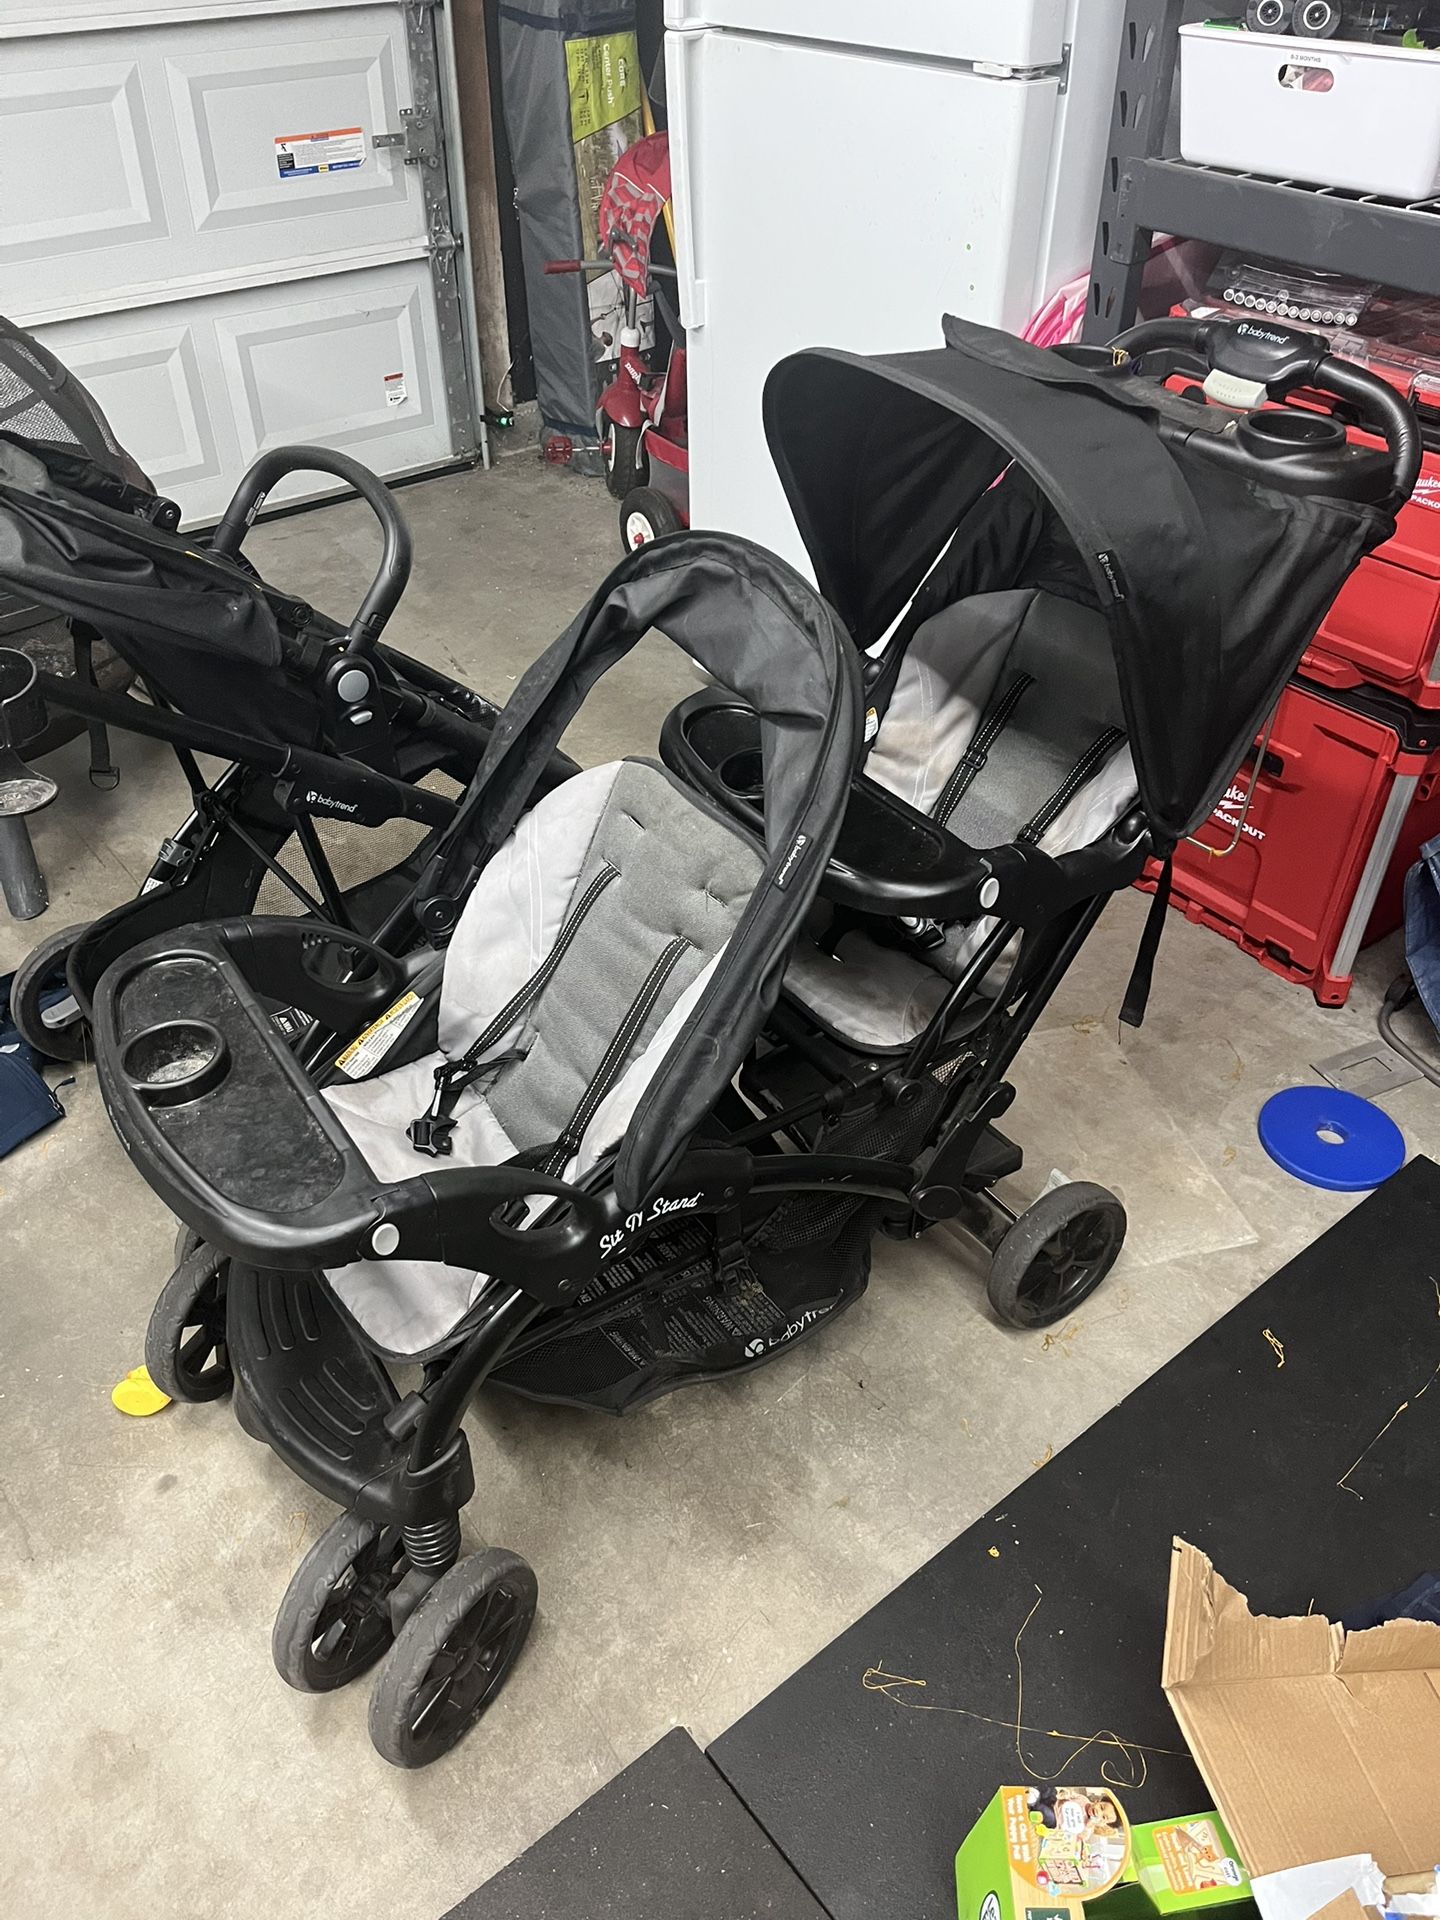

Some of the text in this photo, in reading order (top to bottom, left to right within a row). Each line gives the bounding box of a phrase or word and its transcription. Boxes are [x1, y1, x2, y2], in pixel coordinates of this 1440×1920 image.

[603, 43, 615, 104] Center Push
[1247, 325, 1290, 345] babytrend
[317, 793, 359, 813] babytrend
[599, 1229, 625, 1259] Sit
[646, 1191, 702, 1222] Stand
